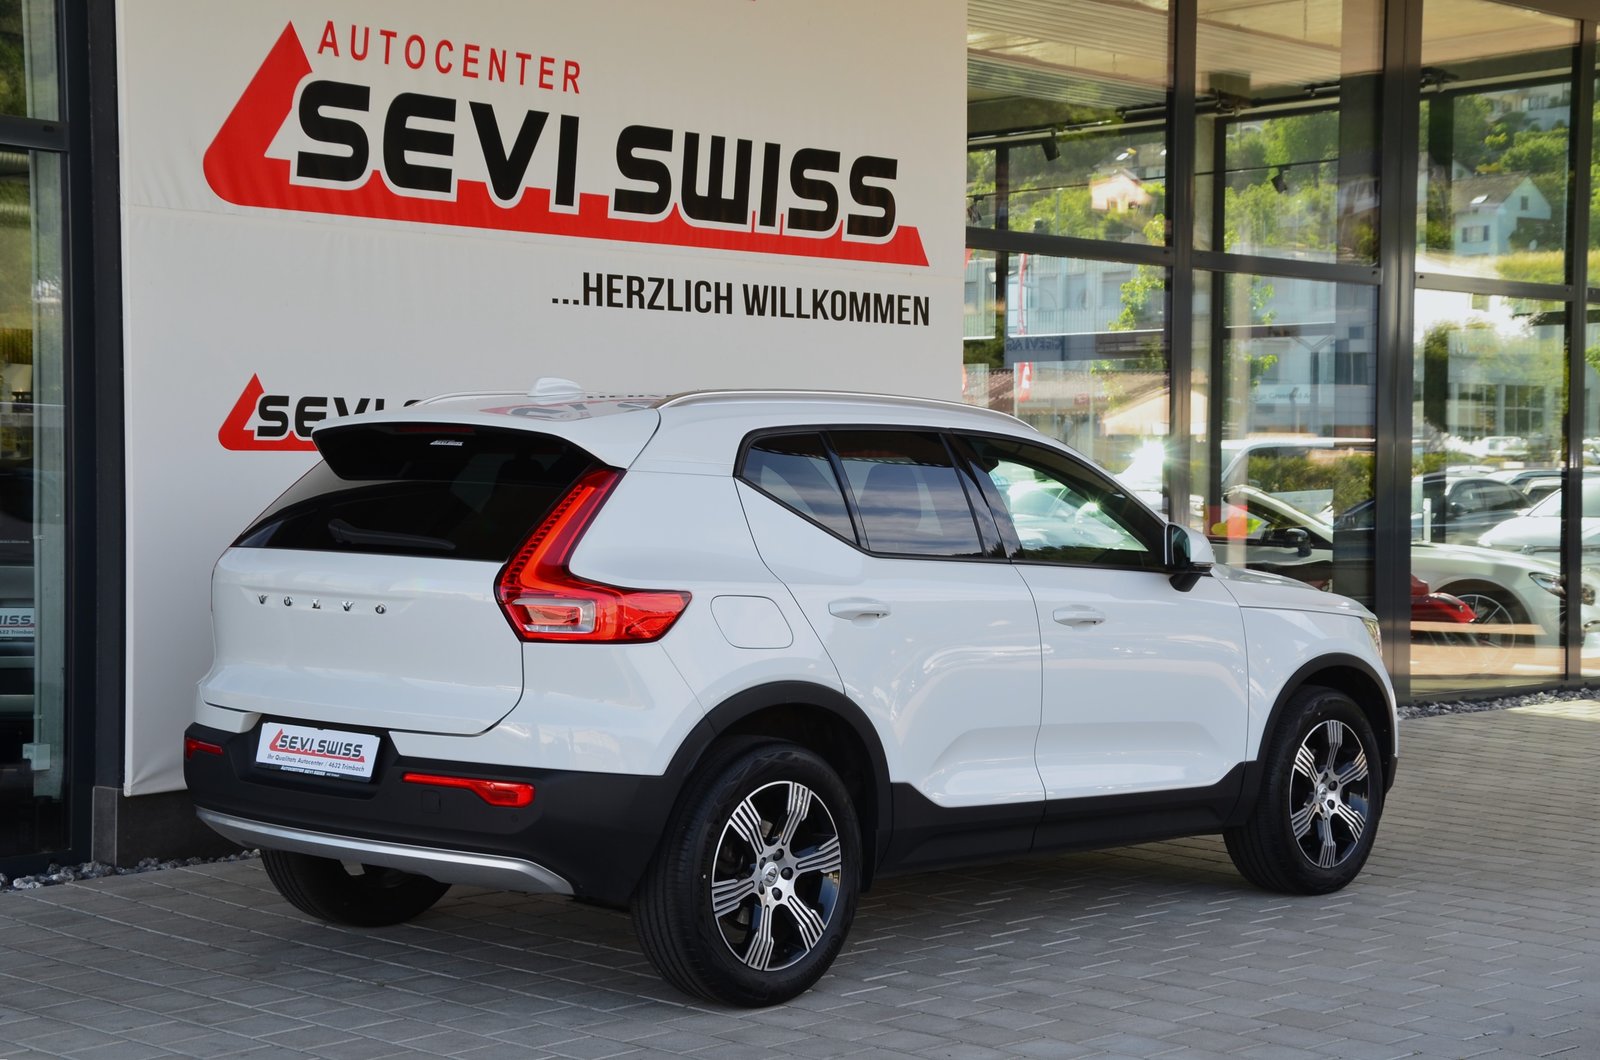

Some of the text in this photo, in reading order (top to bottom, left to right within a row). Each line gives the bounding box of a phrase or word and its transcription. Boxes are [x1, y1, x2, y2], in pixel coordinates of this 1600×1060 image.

[318, 21, 580, 93] AUTOCENTER
[296, 80, 898, 238] SEVI SWISS
[743, 284, 930, 326] WILLKOMMEN
[257, 396, 385, 437] SE
[257, 593, 387, 615] VOLVO
[279, 735, 363, 758] SEVI SWISS
[297, 757, 324, 767] Autocenter
[341, 763, 365, 772] Trimbach
